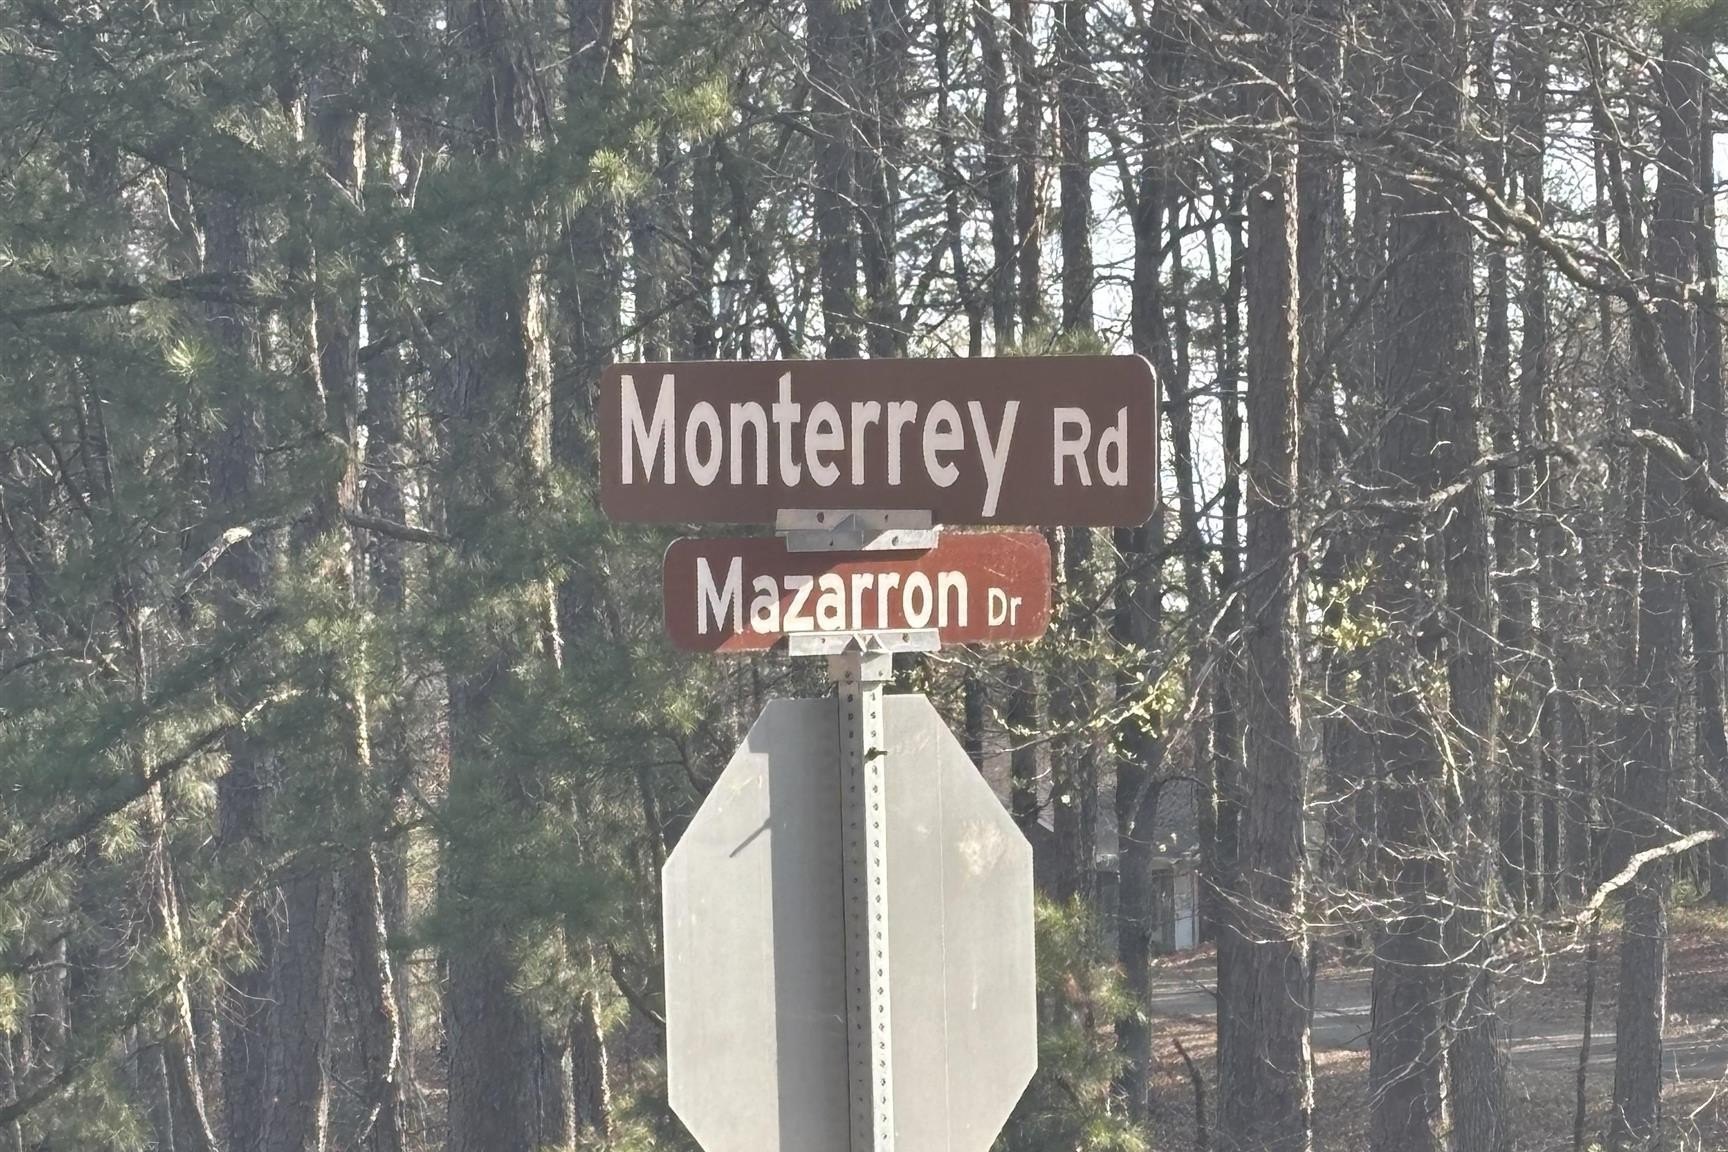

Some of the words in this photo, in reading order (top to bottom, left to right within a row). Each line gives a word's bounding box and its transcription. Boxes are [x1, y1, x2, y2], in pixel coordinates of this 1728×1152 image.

[620, 370, 1021, 518] Monterrey
[1053, 405, 1129, 487] Rd
[696, 556, 969, 635] Mazarron
[987, 587, 1023, 627] Dr
